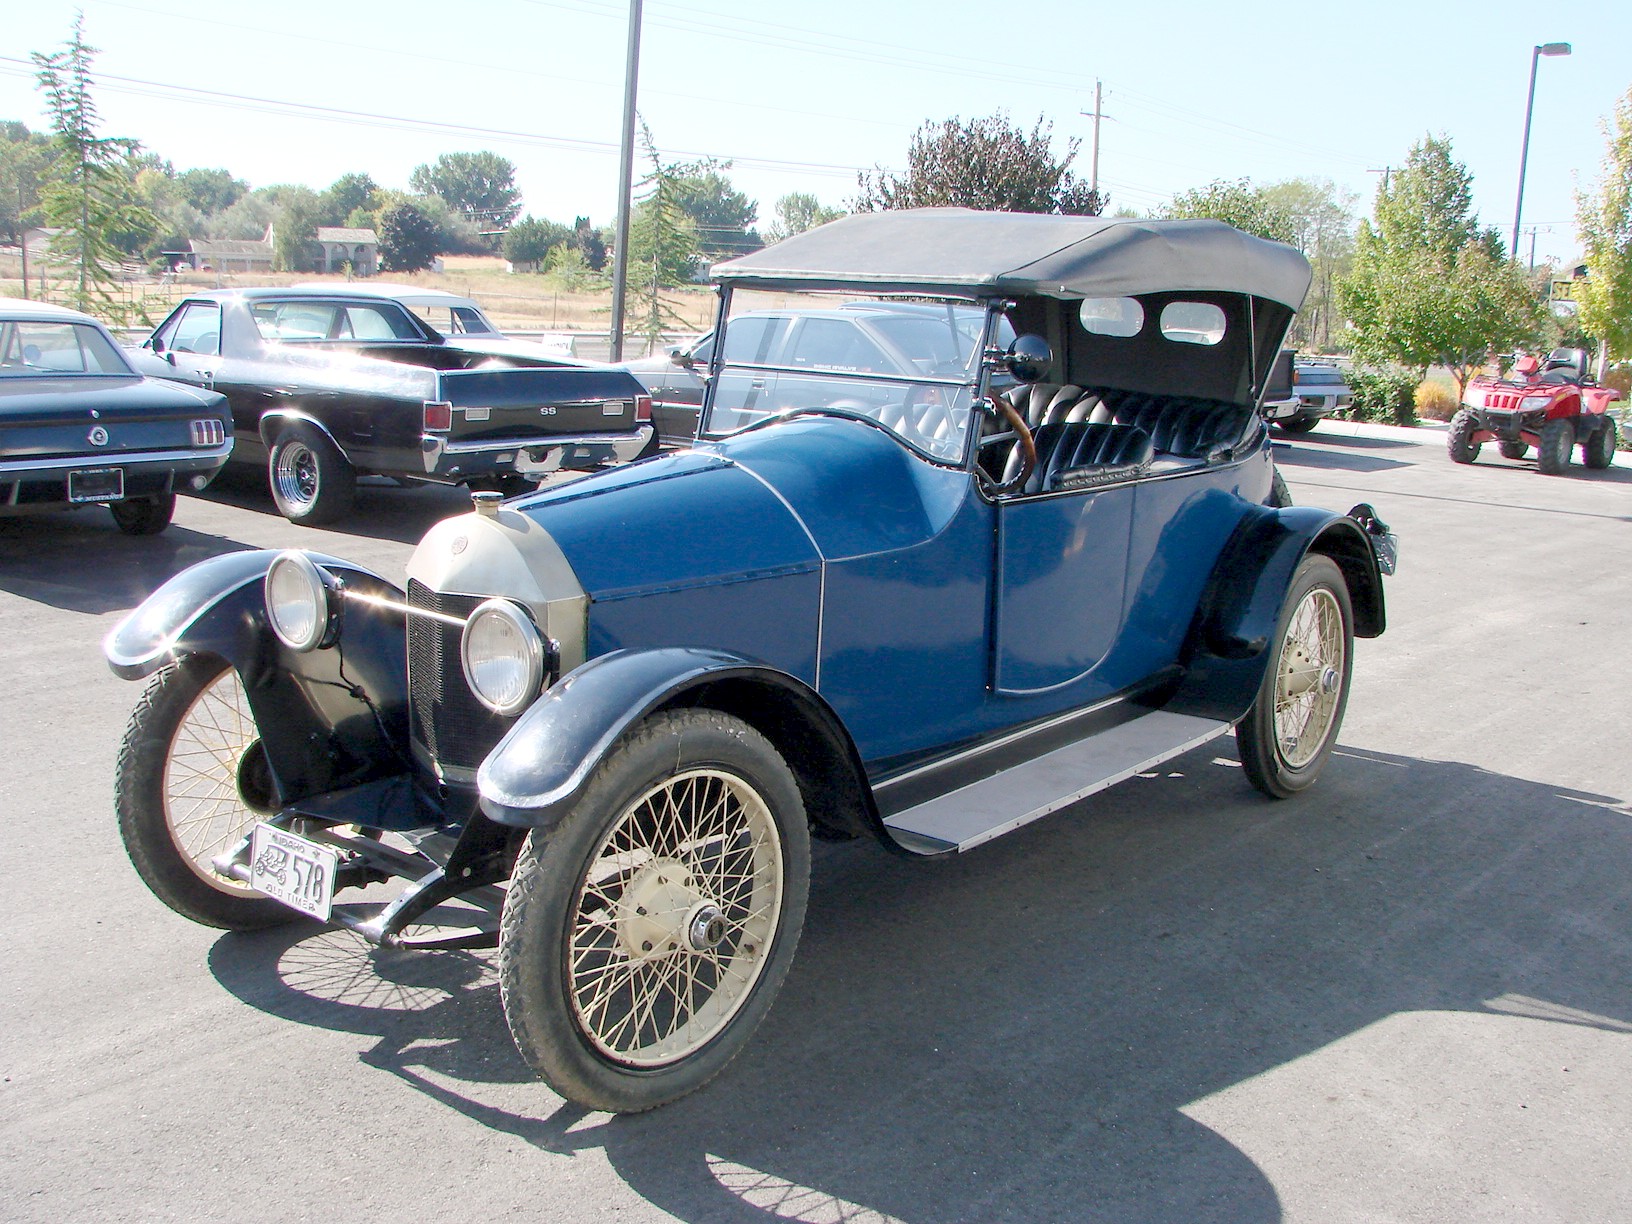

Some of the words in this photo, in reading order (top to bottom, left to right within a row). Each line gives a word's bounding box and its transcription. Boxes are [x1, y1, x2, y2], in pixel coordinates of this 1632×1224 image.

[540, 407, 557, 416] SS
[279, 836, 305, 854] IDAHO
[294, 855, 324, 905] 578
[266, 883, 283, 897] OLD
[287, 892, 316, 912] TIMER
